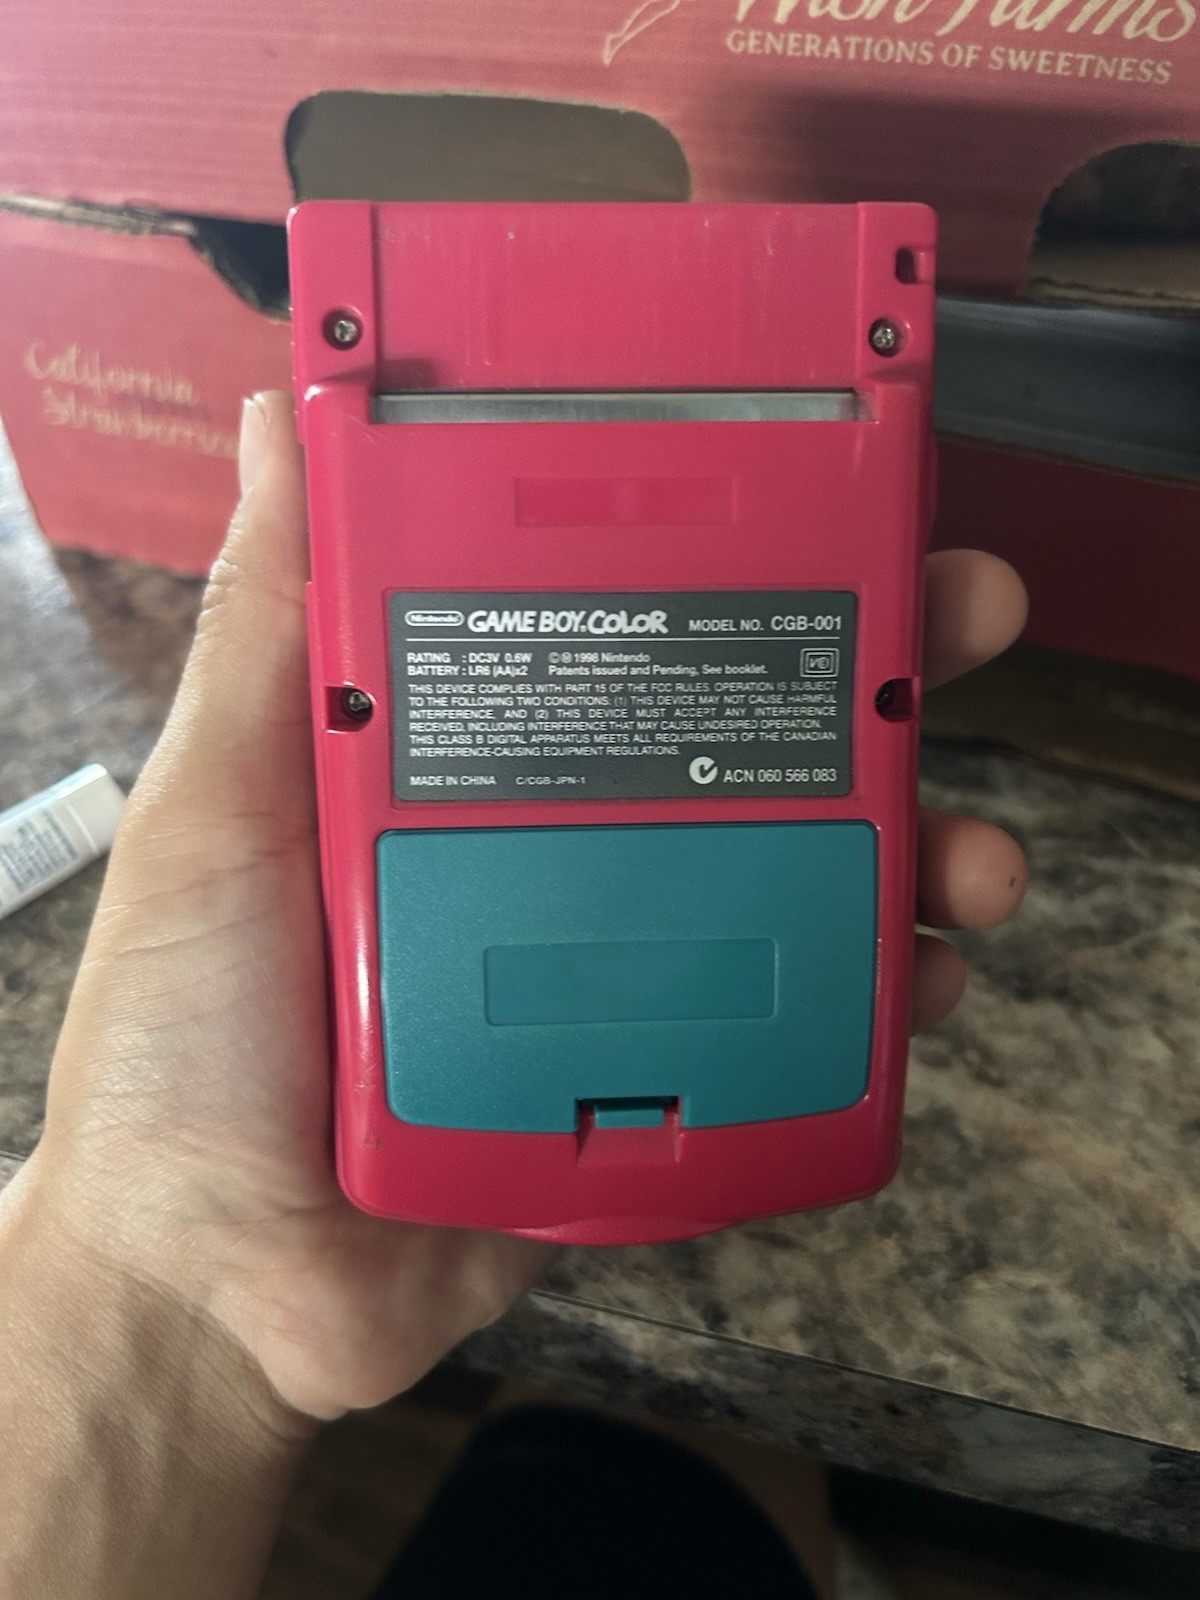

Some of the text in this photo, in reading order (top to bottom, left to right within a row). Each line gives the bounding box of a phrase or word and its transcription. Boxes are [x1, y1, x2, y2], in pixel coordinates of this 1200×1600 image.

[726, 29, 1172, 84] GENERATIONS OF SWEETNESS
[408, 612, 462, 624] Nintendo
[467, 609, 669, 635] GAME BOY COLOR
[689, 615, 842, 632] MODEL NO. CGB-001
[407, 653, 451, 663] RATING
[504, 653, 533, 663] 0.6W
[601, 652, 651, 663] Nintendo
[407, 665, 460, 676] BATTERY
[469, 665, 491, 676] LR6
[548, 665, 590, 676] Patents
[592, 665, 628, 676] issued
[629, 664, 651, 675] and
[702, 664, 723, 675] See
[725, 664, 769, 675] booklet.
[408, 683, 434, 694] THIS
[436, 683, 476, 694] DEVICE
[478, 683, 534, 694] COMPLIES
[535, 683, 562, 693] WITH
[565, 683, 592, 693] PART
[594, 683, 607, 693] 15
[609, 683, 625, 693] OF
[627, 682, 648, 693] THE
[651, 682, 673, 692] FCC
[714, 681, 774, 692] OPERATION
[777, 681, 788, 691] IS
[790, 681, 838, 691] SUBJECT
[408, 696, 425, 707] TO
[426, 696, 449, 707] THE
[451, 696, 514, 707] FOLLOWING
[516, 696, 542, 706] TWO
[630, 695, 654, 706] THIS
[657, 695, 696, 705] DEVICE
[698, 694, 720, 705] MAY
[723, 694, 746, 705] NOT
[748, 694, 784, 705] CAUSE
[787, 693, 838, 704] HARMFUL
[504, 709, 528, 719] AND
[535, 708, 550, 721] (2)
[556, 708, 582, 719] THIS
[588, 708, 628, 719] DEVICE
[635, 707, 666, 718] MUST
[673, 707, 717, 718] ACCEPT
[724, 707, 747, 717] ANY
[754, 706, 838, 717] INTERFERENCE
[467, 722, 526, 732] INCLUDING
[527, 721, 607, 732] INTERFERENCE
[609, 721, 636, 731] THAT
[636, 721, 659, 731] MAY
[660, 720, 696, 731] CAUSE
[698, 719, 759, 730] UNDESIRED
[409, 731, 837, 745] THIS CLASS B DIGITAL APPARATUS MEETS ALL REQUIREMENTS OF THE CANADIAN
[409, 747, 541, 757] INTERFERENCE-CAUSING
[543, 746, 605, 756] EQUIPMENT
[409, 775, 497, 786] MADE IN CHINA
[722, 768, 838, 783] ACN 060 566 083
